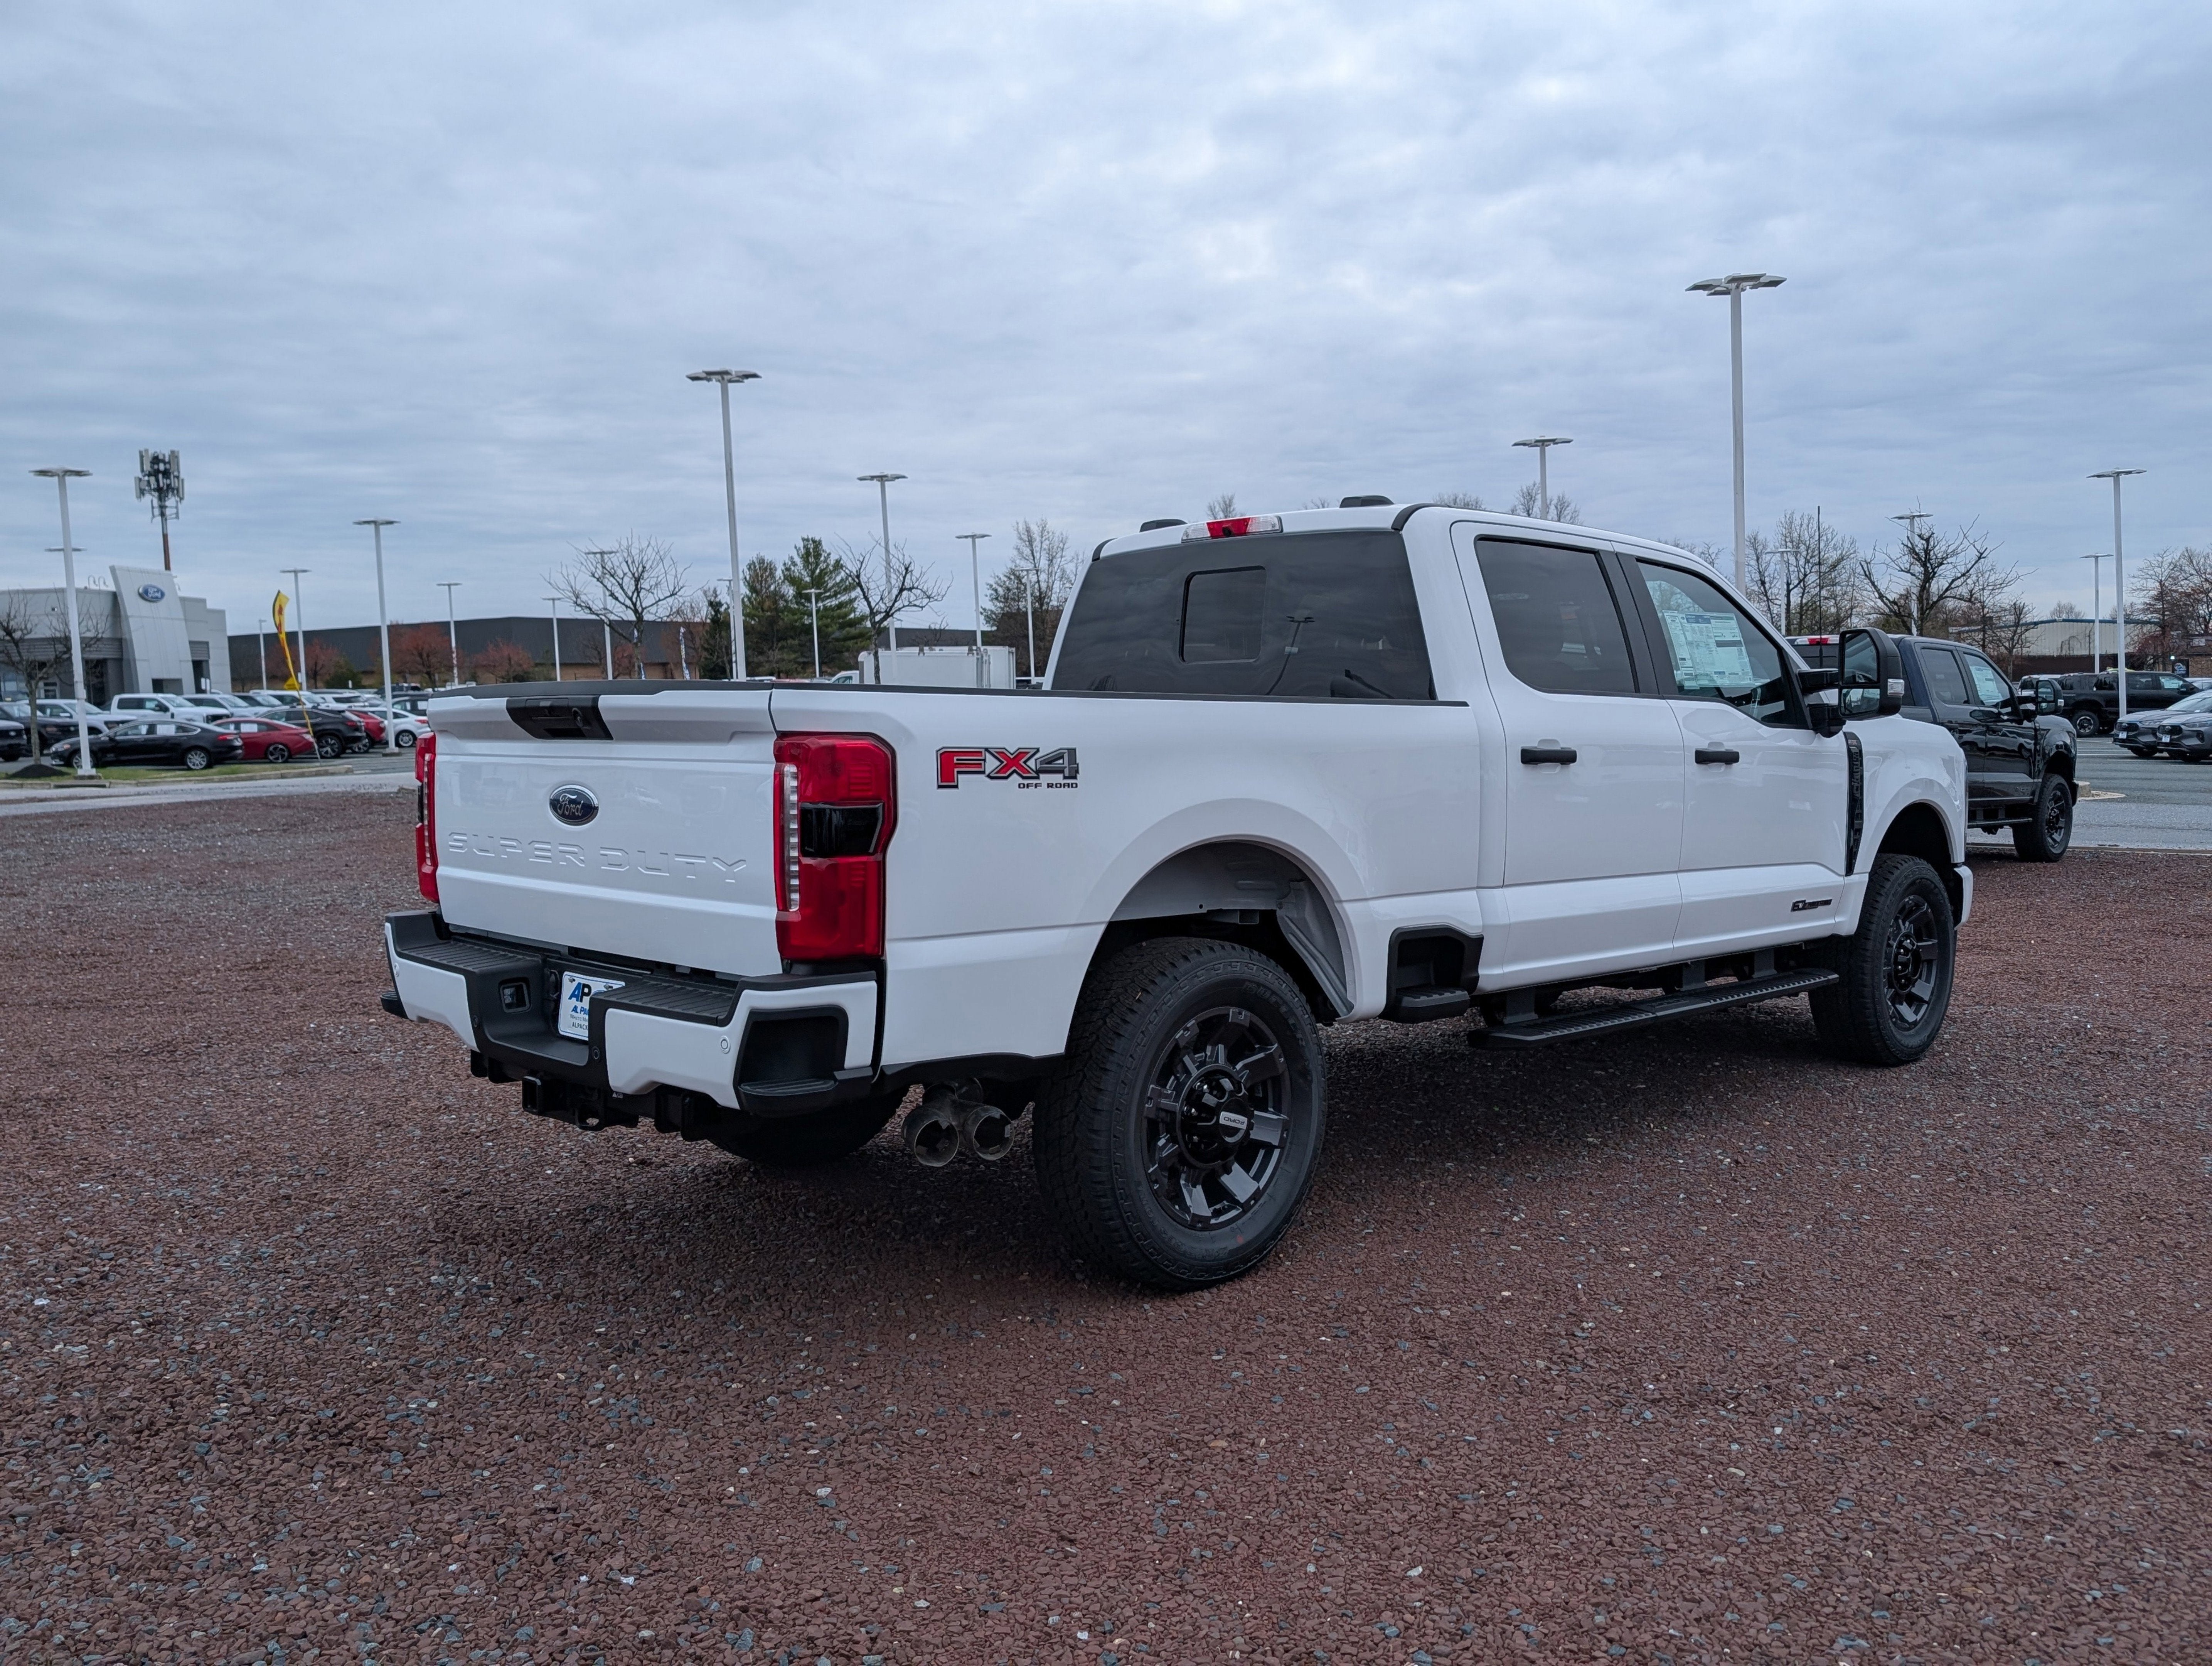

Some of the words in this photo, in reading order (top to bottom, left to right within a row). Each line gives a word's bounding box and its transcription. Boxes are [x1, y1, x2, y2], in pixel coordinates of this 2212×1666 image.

[148, 587, 161, 599] Ford
[937, 746, 1079, 789] FX4
[557, 793, 583, 816] Ford
[448, 832, 585, 867] SUPER
[600, 846, 746, 883] DUTY
[568, 982, 592, 1003] AP
[571, 1005, 579, 1013] AL
[580, 1006, 589, 1016] PA
[572, 1022, 589, 1030] ALPACK
[1223, 1116, 1245, 1125] FORD
